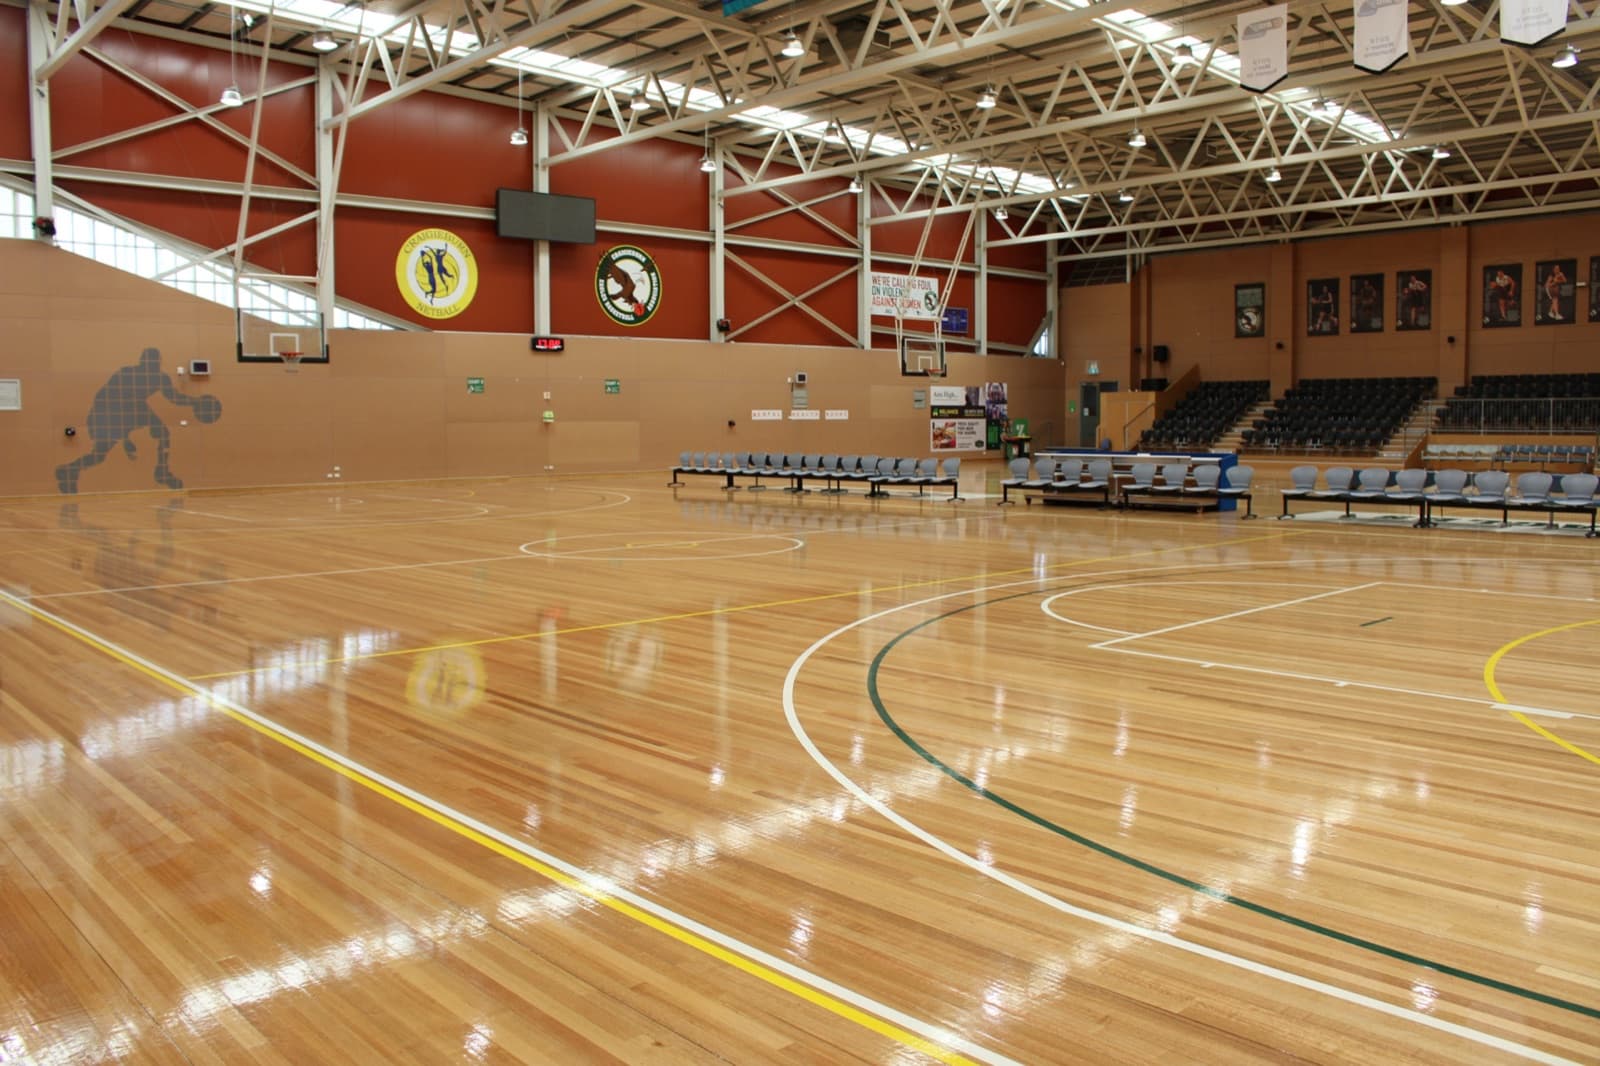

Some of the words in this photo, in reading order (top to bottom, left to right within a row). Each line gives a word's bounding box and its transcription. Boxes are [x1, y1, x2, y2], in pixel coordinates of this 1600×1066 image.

[403, 230, 472, 258] CRAIGIEBURN
[872, 285, 880, 296] ON
[891, 276, 917, 289] CALLNG
[917, 279, 932, 291] FOUL
[872, 296, 897, 307] AGAINST
[416, 302, 461, 317] NETBALL
